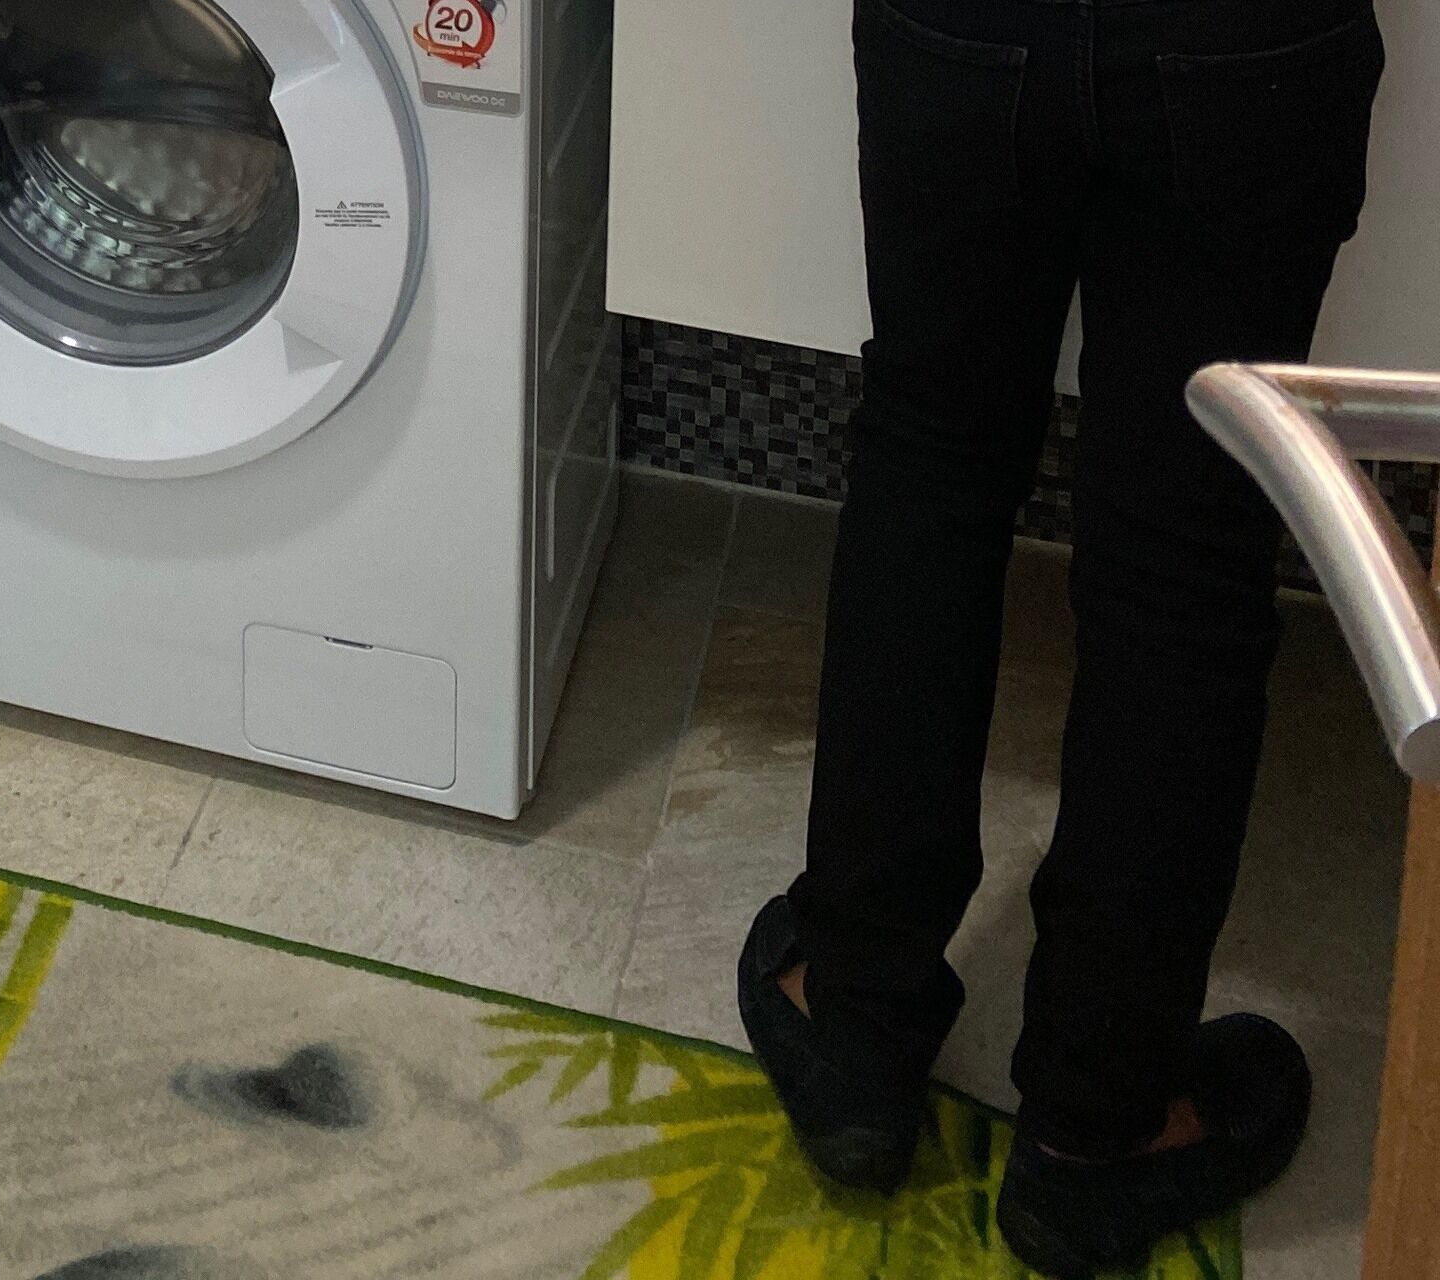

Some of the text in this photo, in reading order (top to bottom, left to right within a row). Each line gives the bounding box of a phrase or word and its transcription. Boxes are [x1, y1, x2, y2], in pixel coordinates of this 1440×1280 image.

[434, 6, 474, 32] 20
[439, 32, 460, 42] min
[436, 89, 489, 105] DAEWOO
